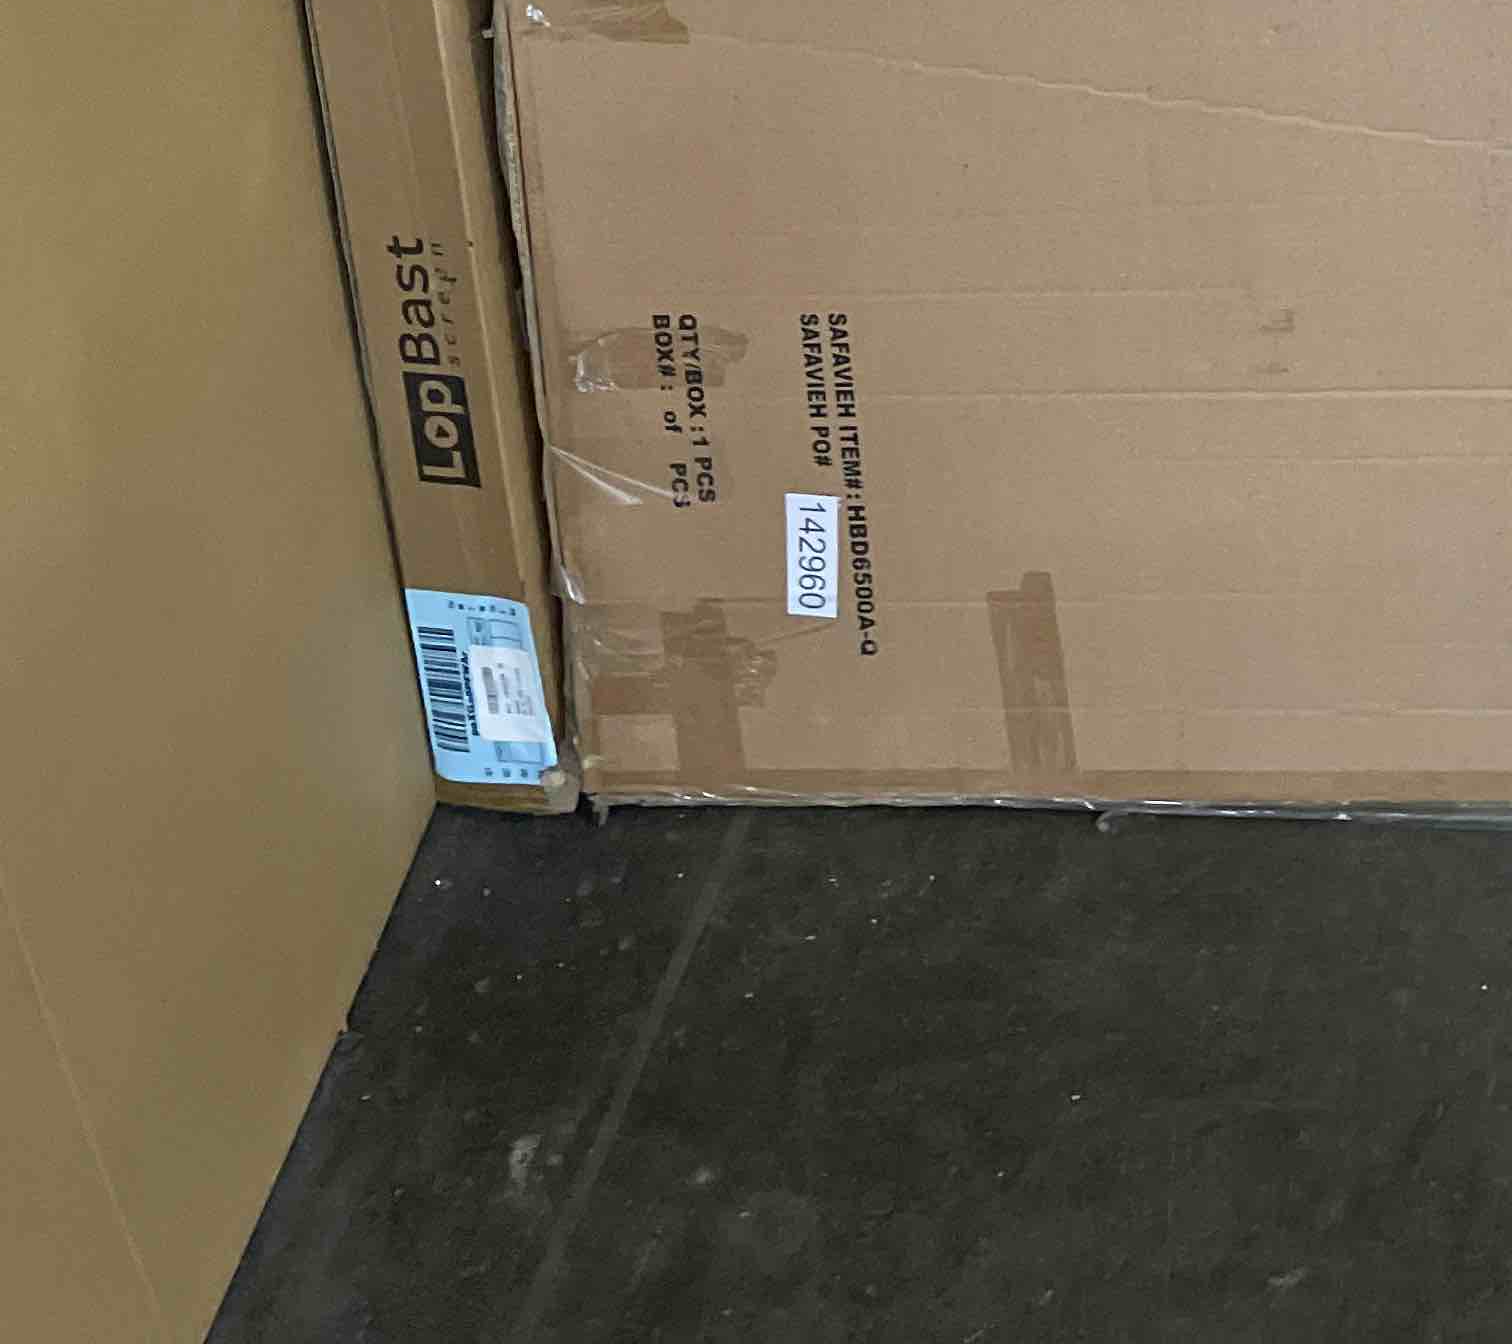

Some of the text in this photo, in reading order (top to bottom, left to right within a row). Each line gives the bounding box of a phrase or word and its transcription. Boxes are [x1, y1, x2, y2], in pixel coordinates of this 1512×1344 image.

[663, 411, 683, 434] of
[677, 313, 707, 419] QTY/BOX
[694, 456, 717, 503] PCS
[799, 312, 833, 467] SAFAVIEH PO#
[798, 501, 827, 610] 142960
[828, 312, 858, 419] SAFAVIEH
[847, 505, 878, 657] HBD6500A-Q
